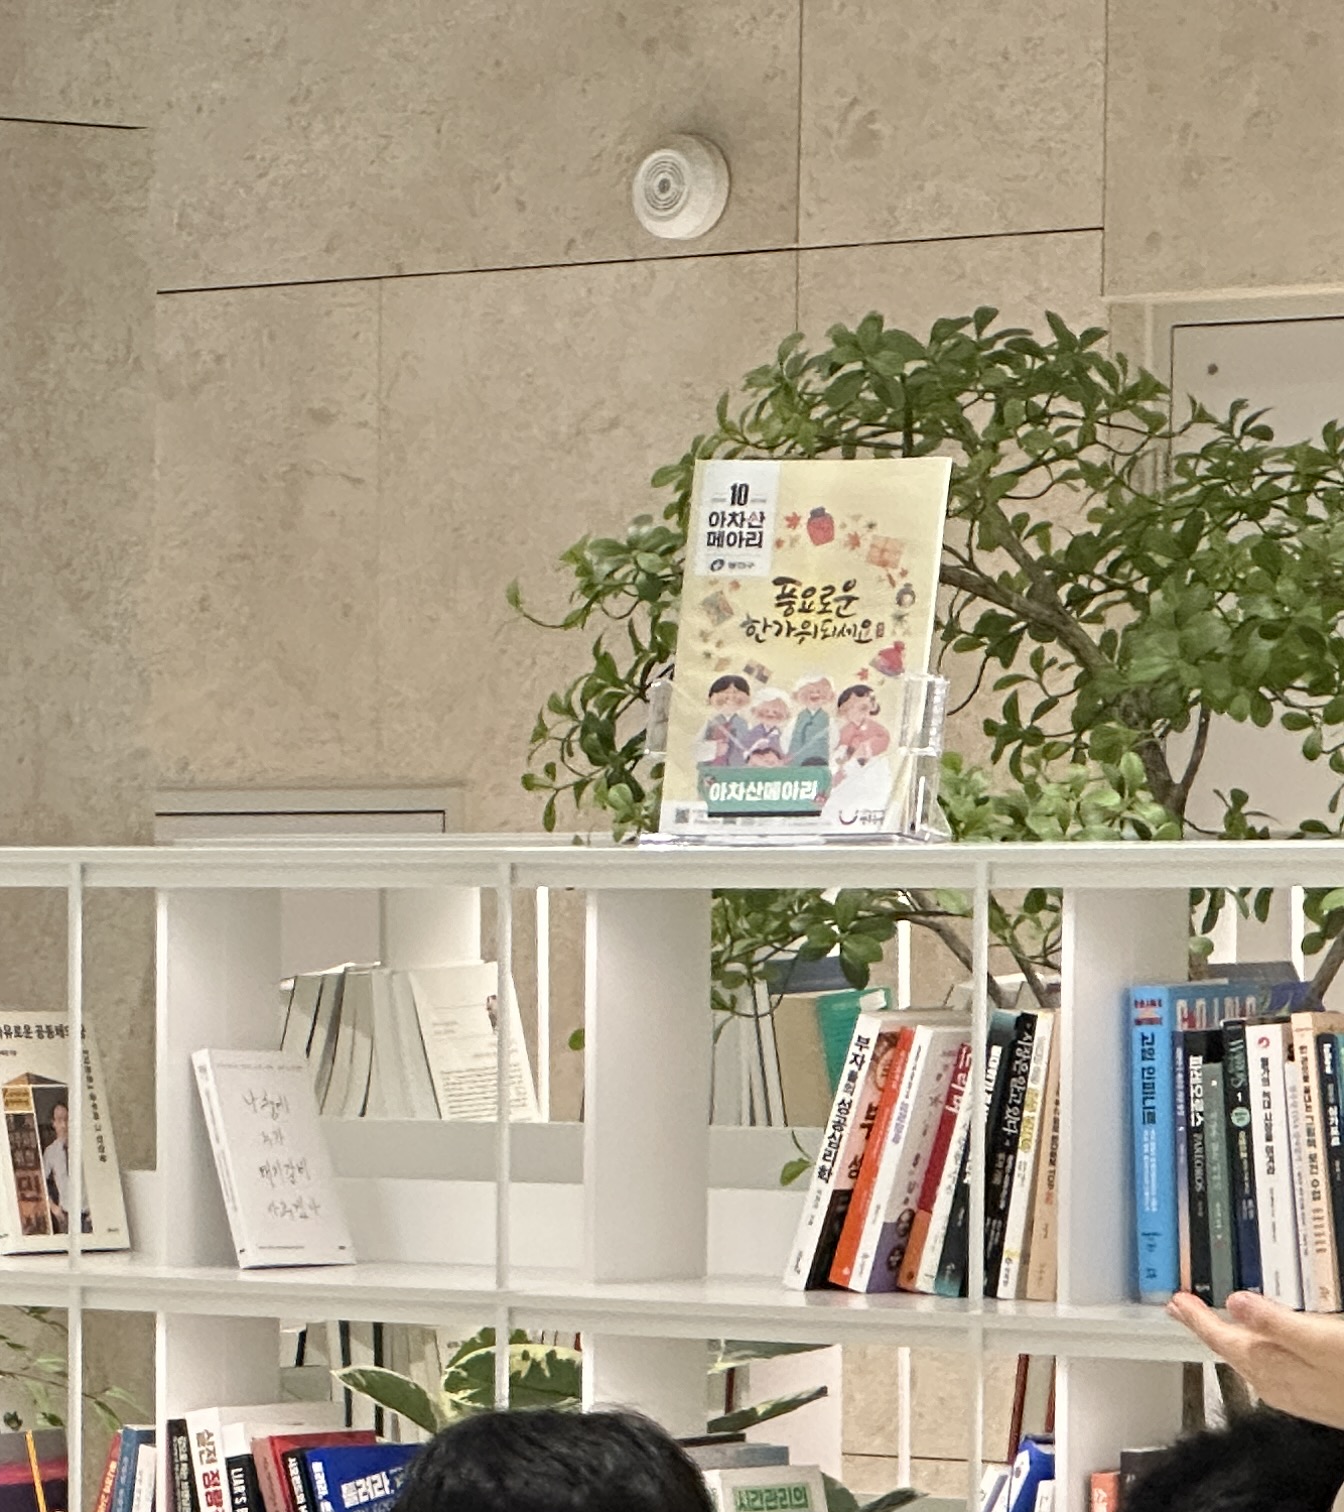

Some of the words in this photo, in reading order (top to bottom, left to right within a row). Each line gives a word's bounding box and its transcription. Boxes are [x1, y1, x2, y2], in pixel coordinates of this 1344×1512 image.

[729, 482, 749, 506] 10
[709, 511, 766, 529] 아차산
[706, 530, 763, 550] 메아리
[772, 577, 860, 614] 풍요로운
[710, 780, 817, 801] 아차산메아리
[1013, 1031, 1032, 1074] 시장은
[1010, 1076, 1026, 1104] 알고
[1142, 1066, 1156, 1125] 인피니트
[1003, 1107, 1021, 1134] 있다
[197, 1429, 218, 1465] 실전
[230, 1468, 248, 1504] LIAR'S
